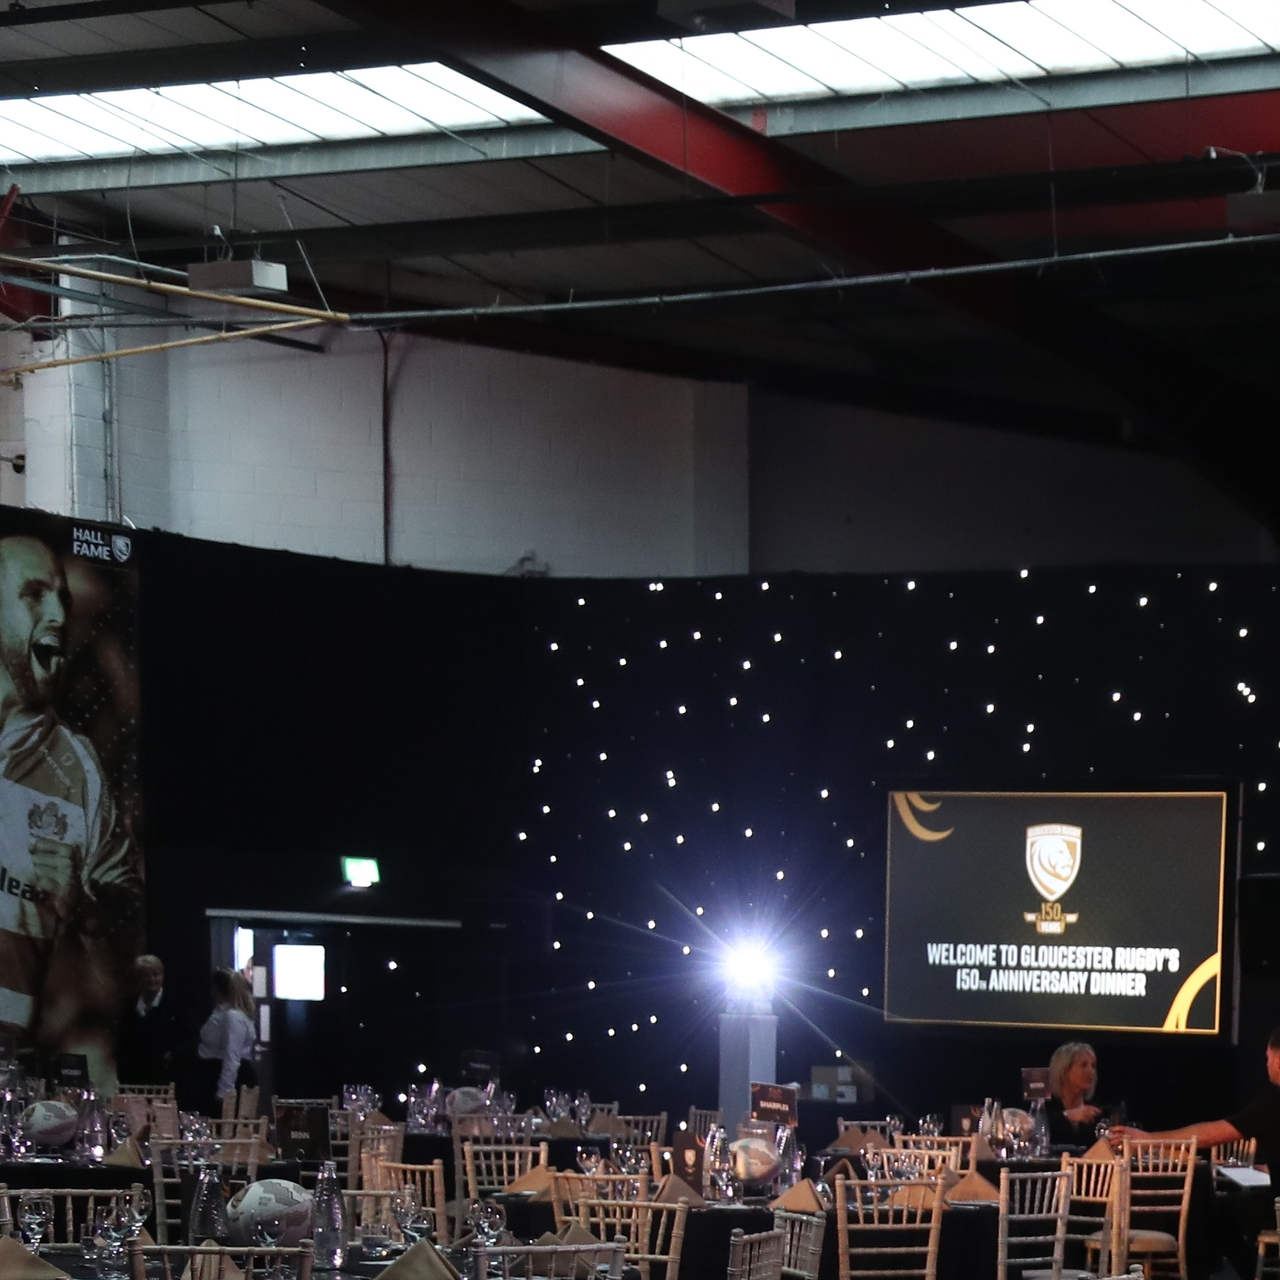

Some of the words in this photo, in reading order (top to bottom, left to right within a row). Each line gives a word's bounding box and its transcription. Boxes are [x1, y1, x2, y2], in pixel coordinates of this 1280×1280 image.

[73, 527, 104, 544] HALL
[73, 541, 112, 561] FAME
[1041, 902, 1061, 920] 150
[927, 943, 997, 966] WELCOME
[1000, 944, 1017, 966] TO
[1020, 945, 1112, 969] GLOUCESTER
[1115, 947, 1180, 973] RUGBY'S
[988, 969, 1088, 995] ANNIVERSARY
[1090, 972, 1146, 996] DINNER
